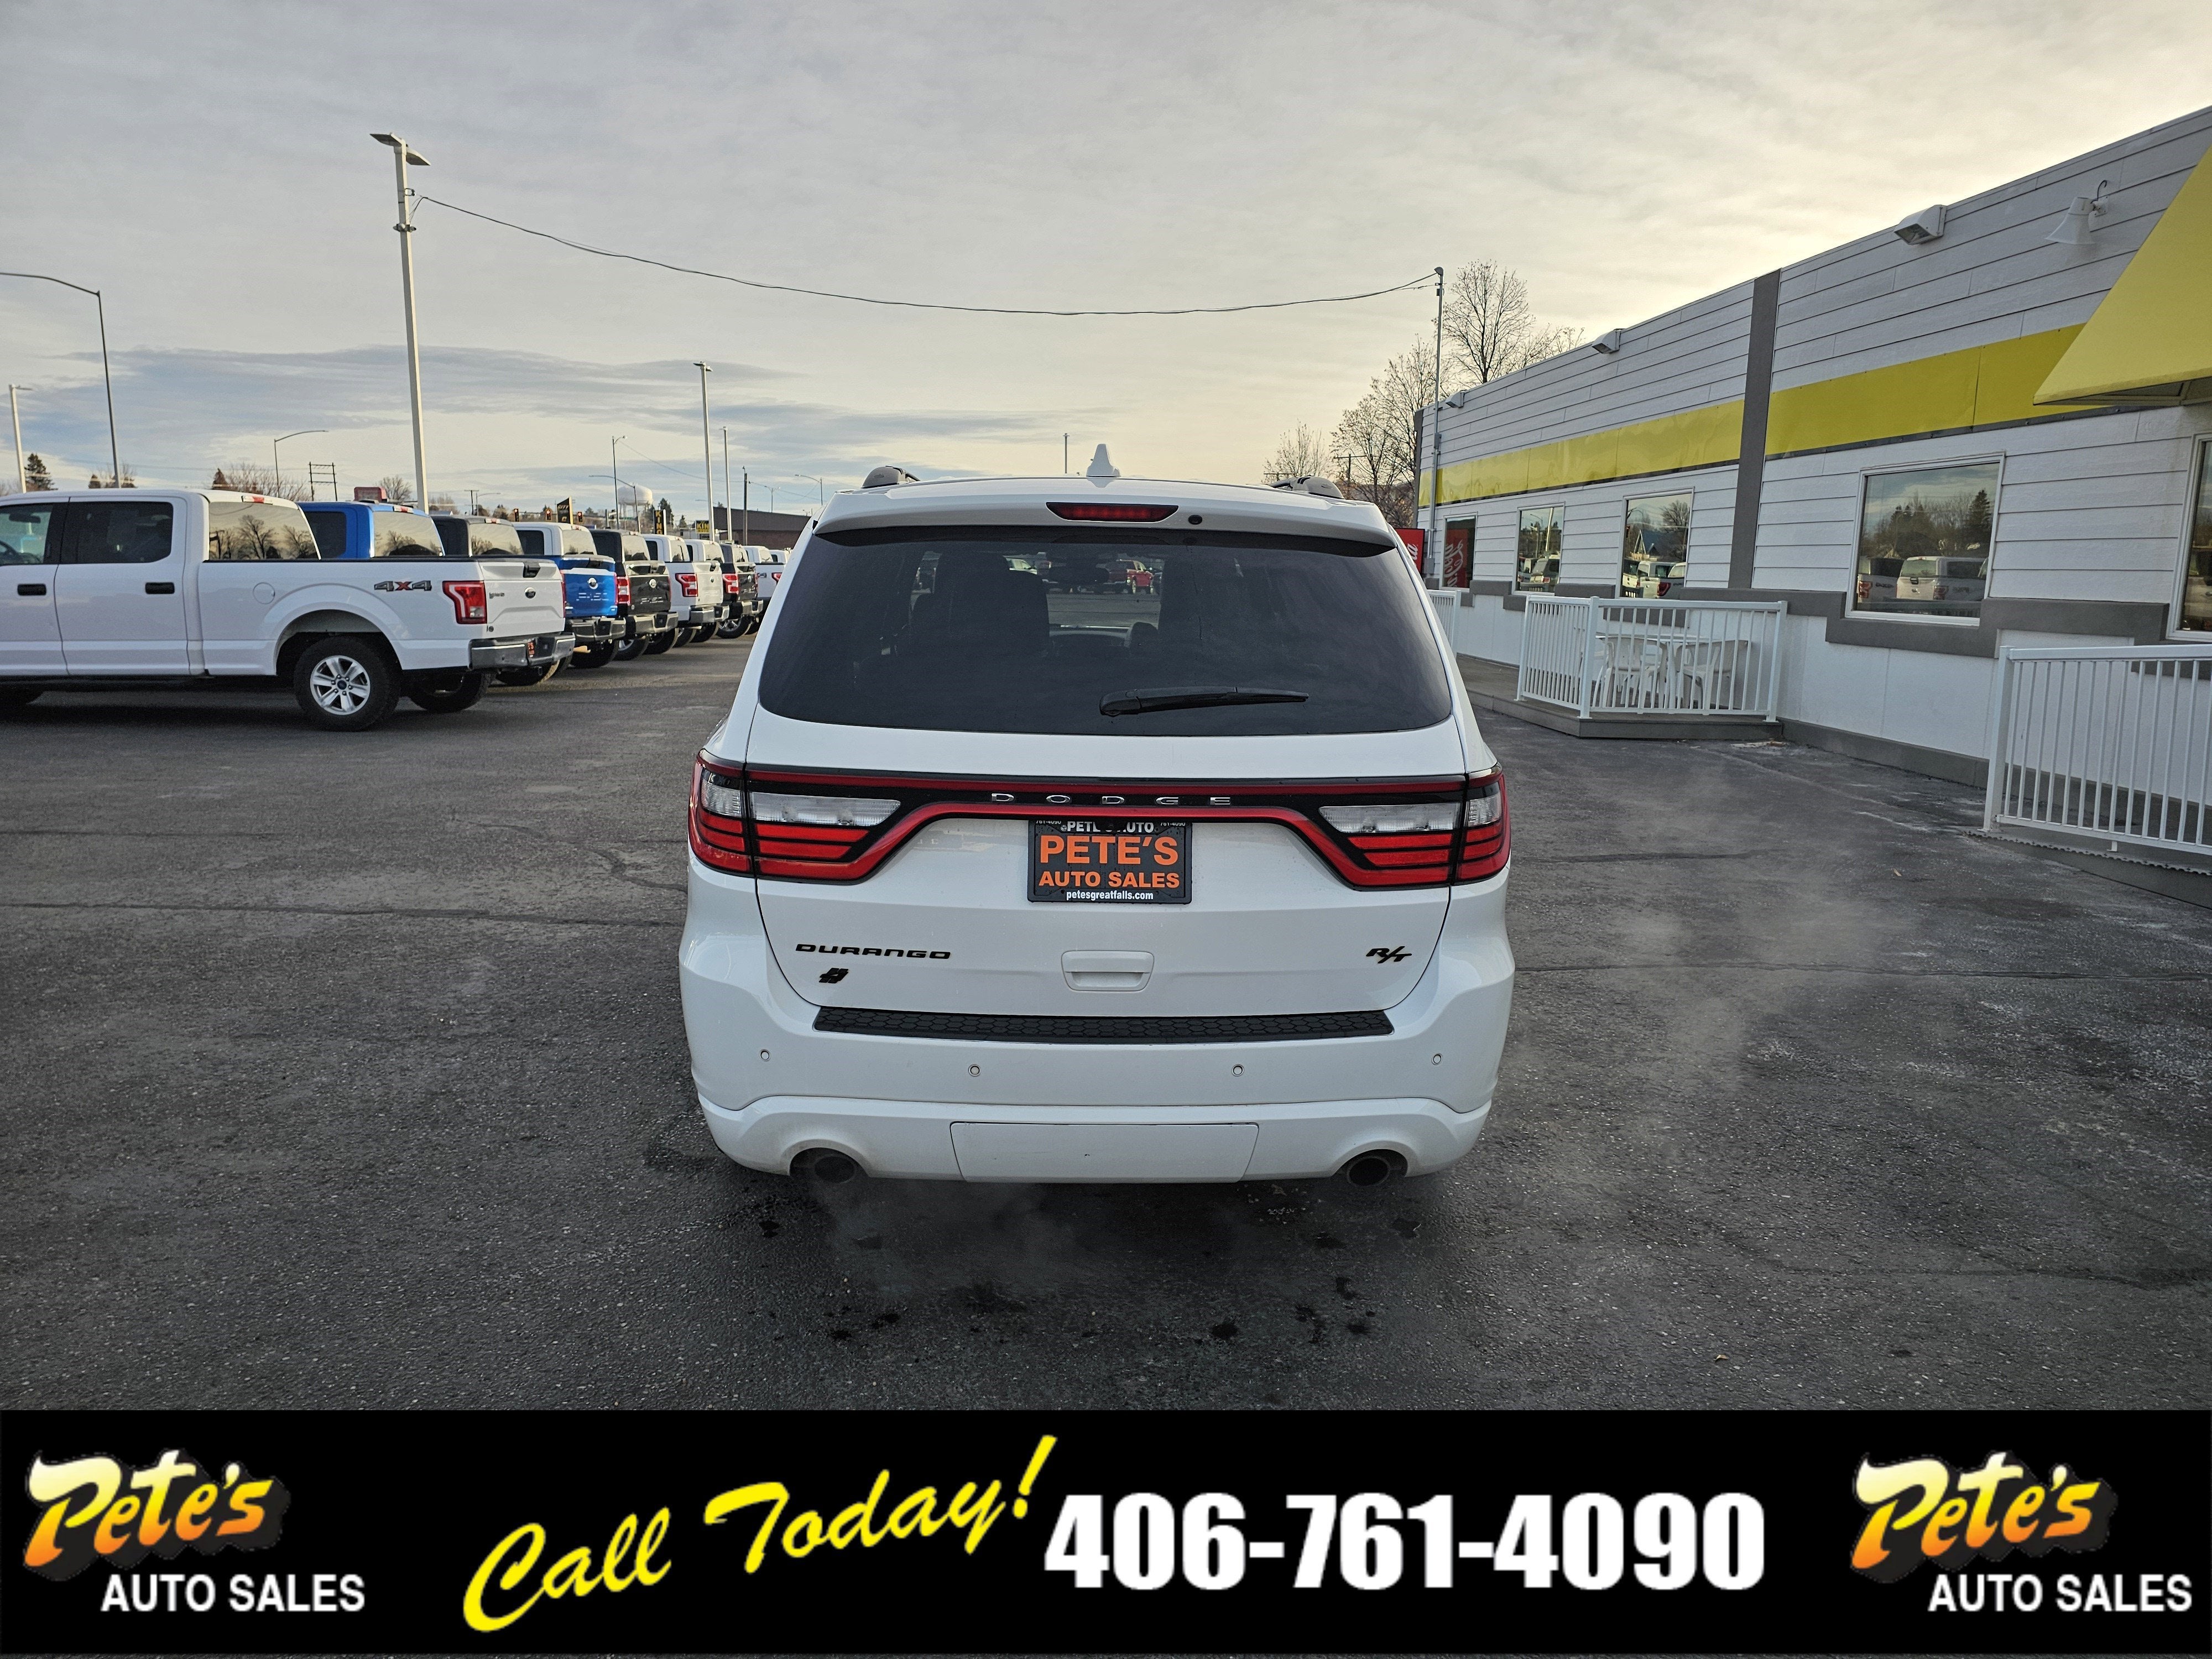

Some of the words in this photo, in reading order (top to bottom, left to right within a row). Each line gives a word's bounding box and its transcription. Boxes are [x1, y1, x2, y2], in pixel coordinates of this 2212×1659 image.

[990, 792, 1232, 806] DODGE
[1117, 822, 1154, 833] UTO
[1040, 835, 1178, 865] PETE'S
[1039, 871, 1100, 887] AUTO
[1108, 872, 1180, 888] SALES
[1066, 890, 1154, 901] petesgreatfalls.com
[795, 943, 951, 959] DURANGO
[1365, 946, 1412, 964] R/T
